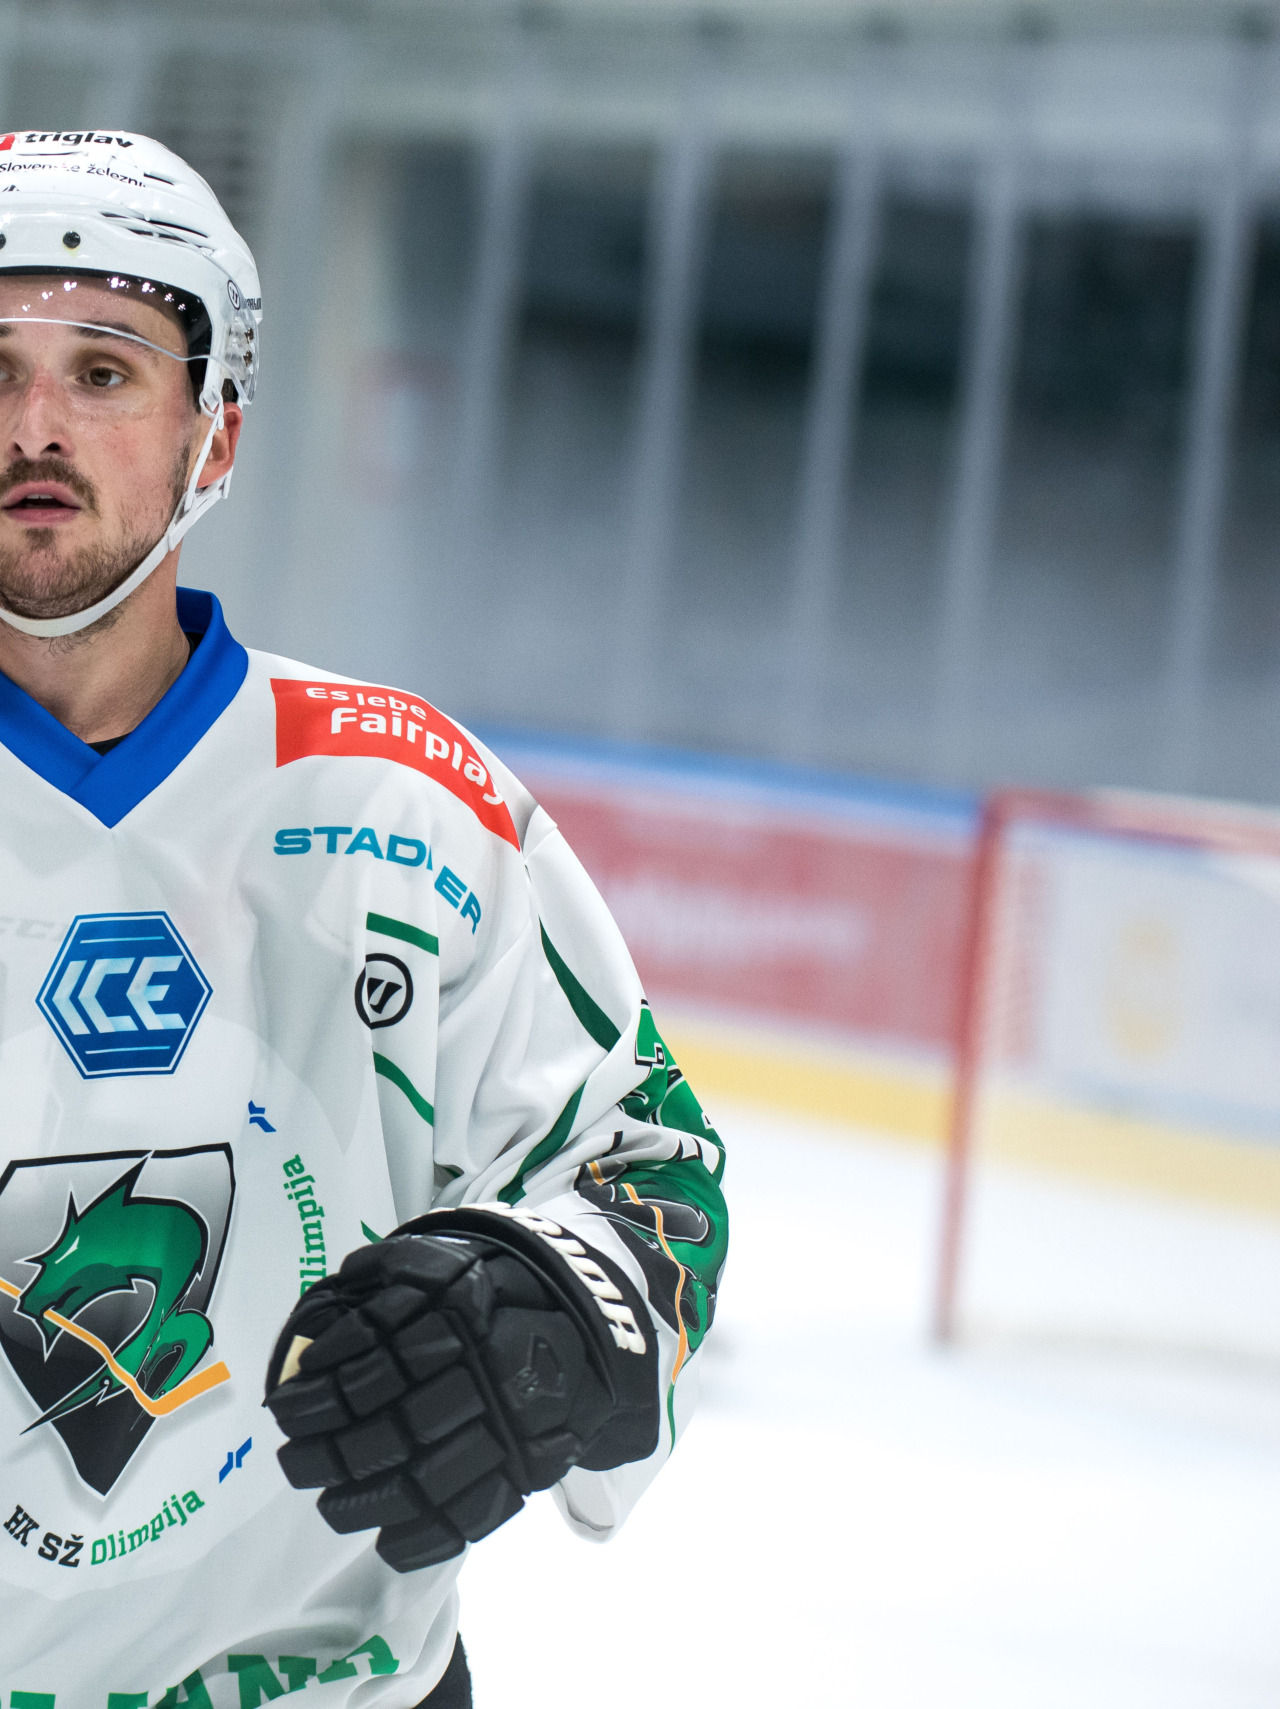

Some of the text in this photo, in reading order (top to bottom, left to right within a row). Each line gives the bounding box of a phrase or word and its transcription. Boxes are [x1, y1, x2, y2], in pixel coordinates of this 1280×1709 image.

[25, 132, 134, 148] triglav
[356, 692, 427, 720] lebe
[331, 707, 505, 805] Fairplay
[52, 955, 188, 1036] ICE
[3, 1490, 206, 1568] HK SŽ Olimpija
